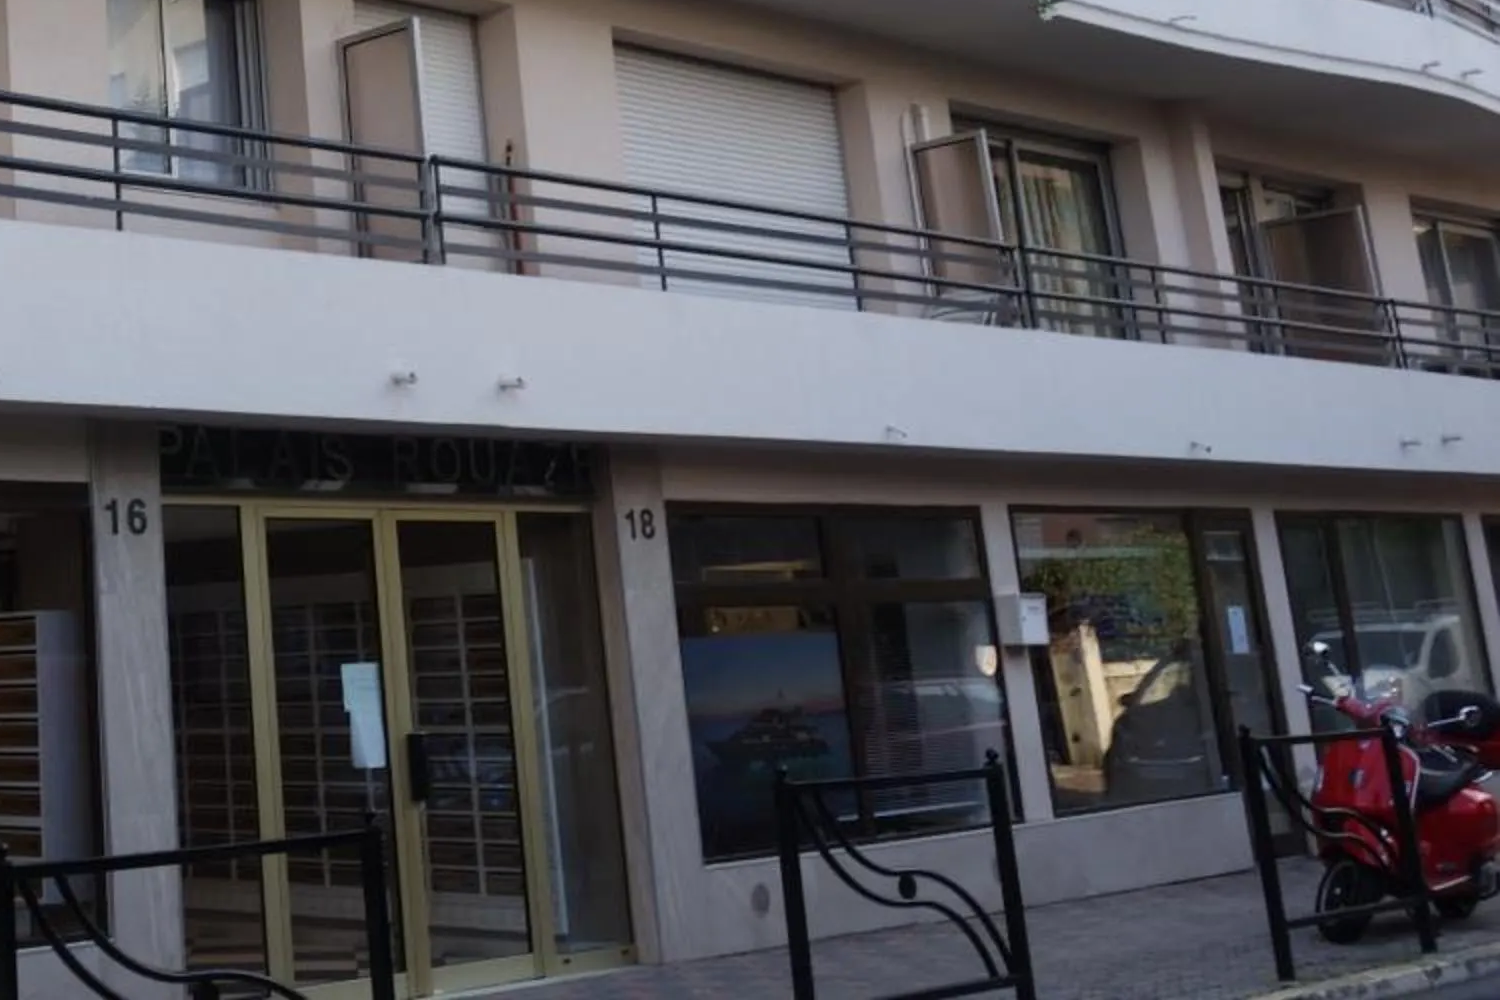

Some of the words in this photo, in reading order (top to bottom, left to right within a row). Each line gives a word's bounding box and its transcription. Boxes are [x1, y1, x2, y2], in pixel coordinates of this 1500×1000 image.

[155, 423, 355, 484] PALAIS
[104, 498, 148, 536] 16
[625, 508, 656, 541] 18
